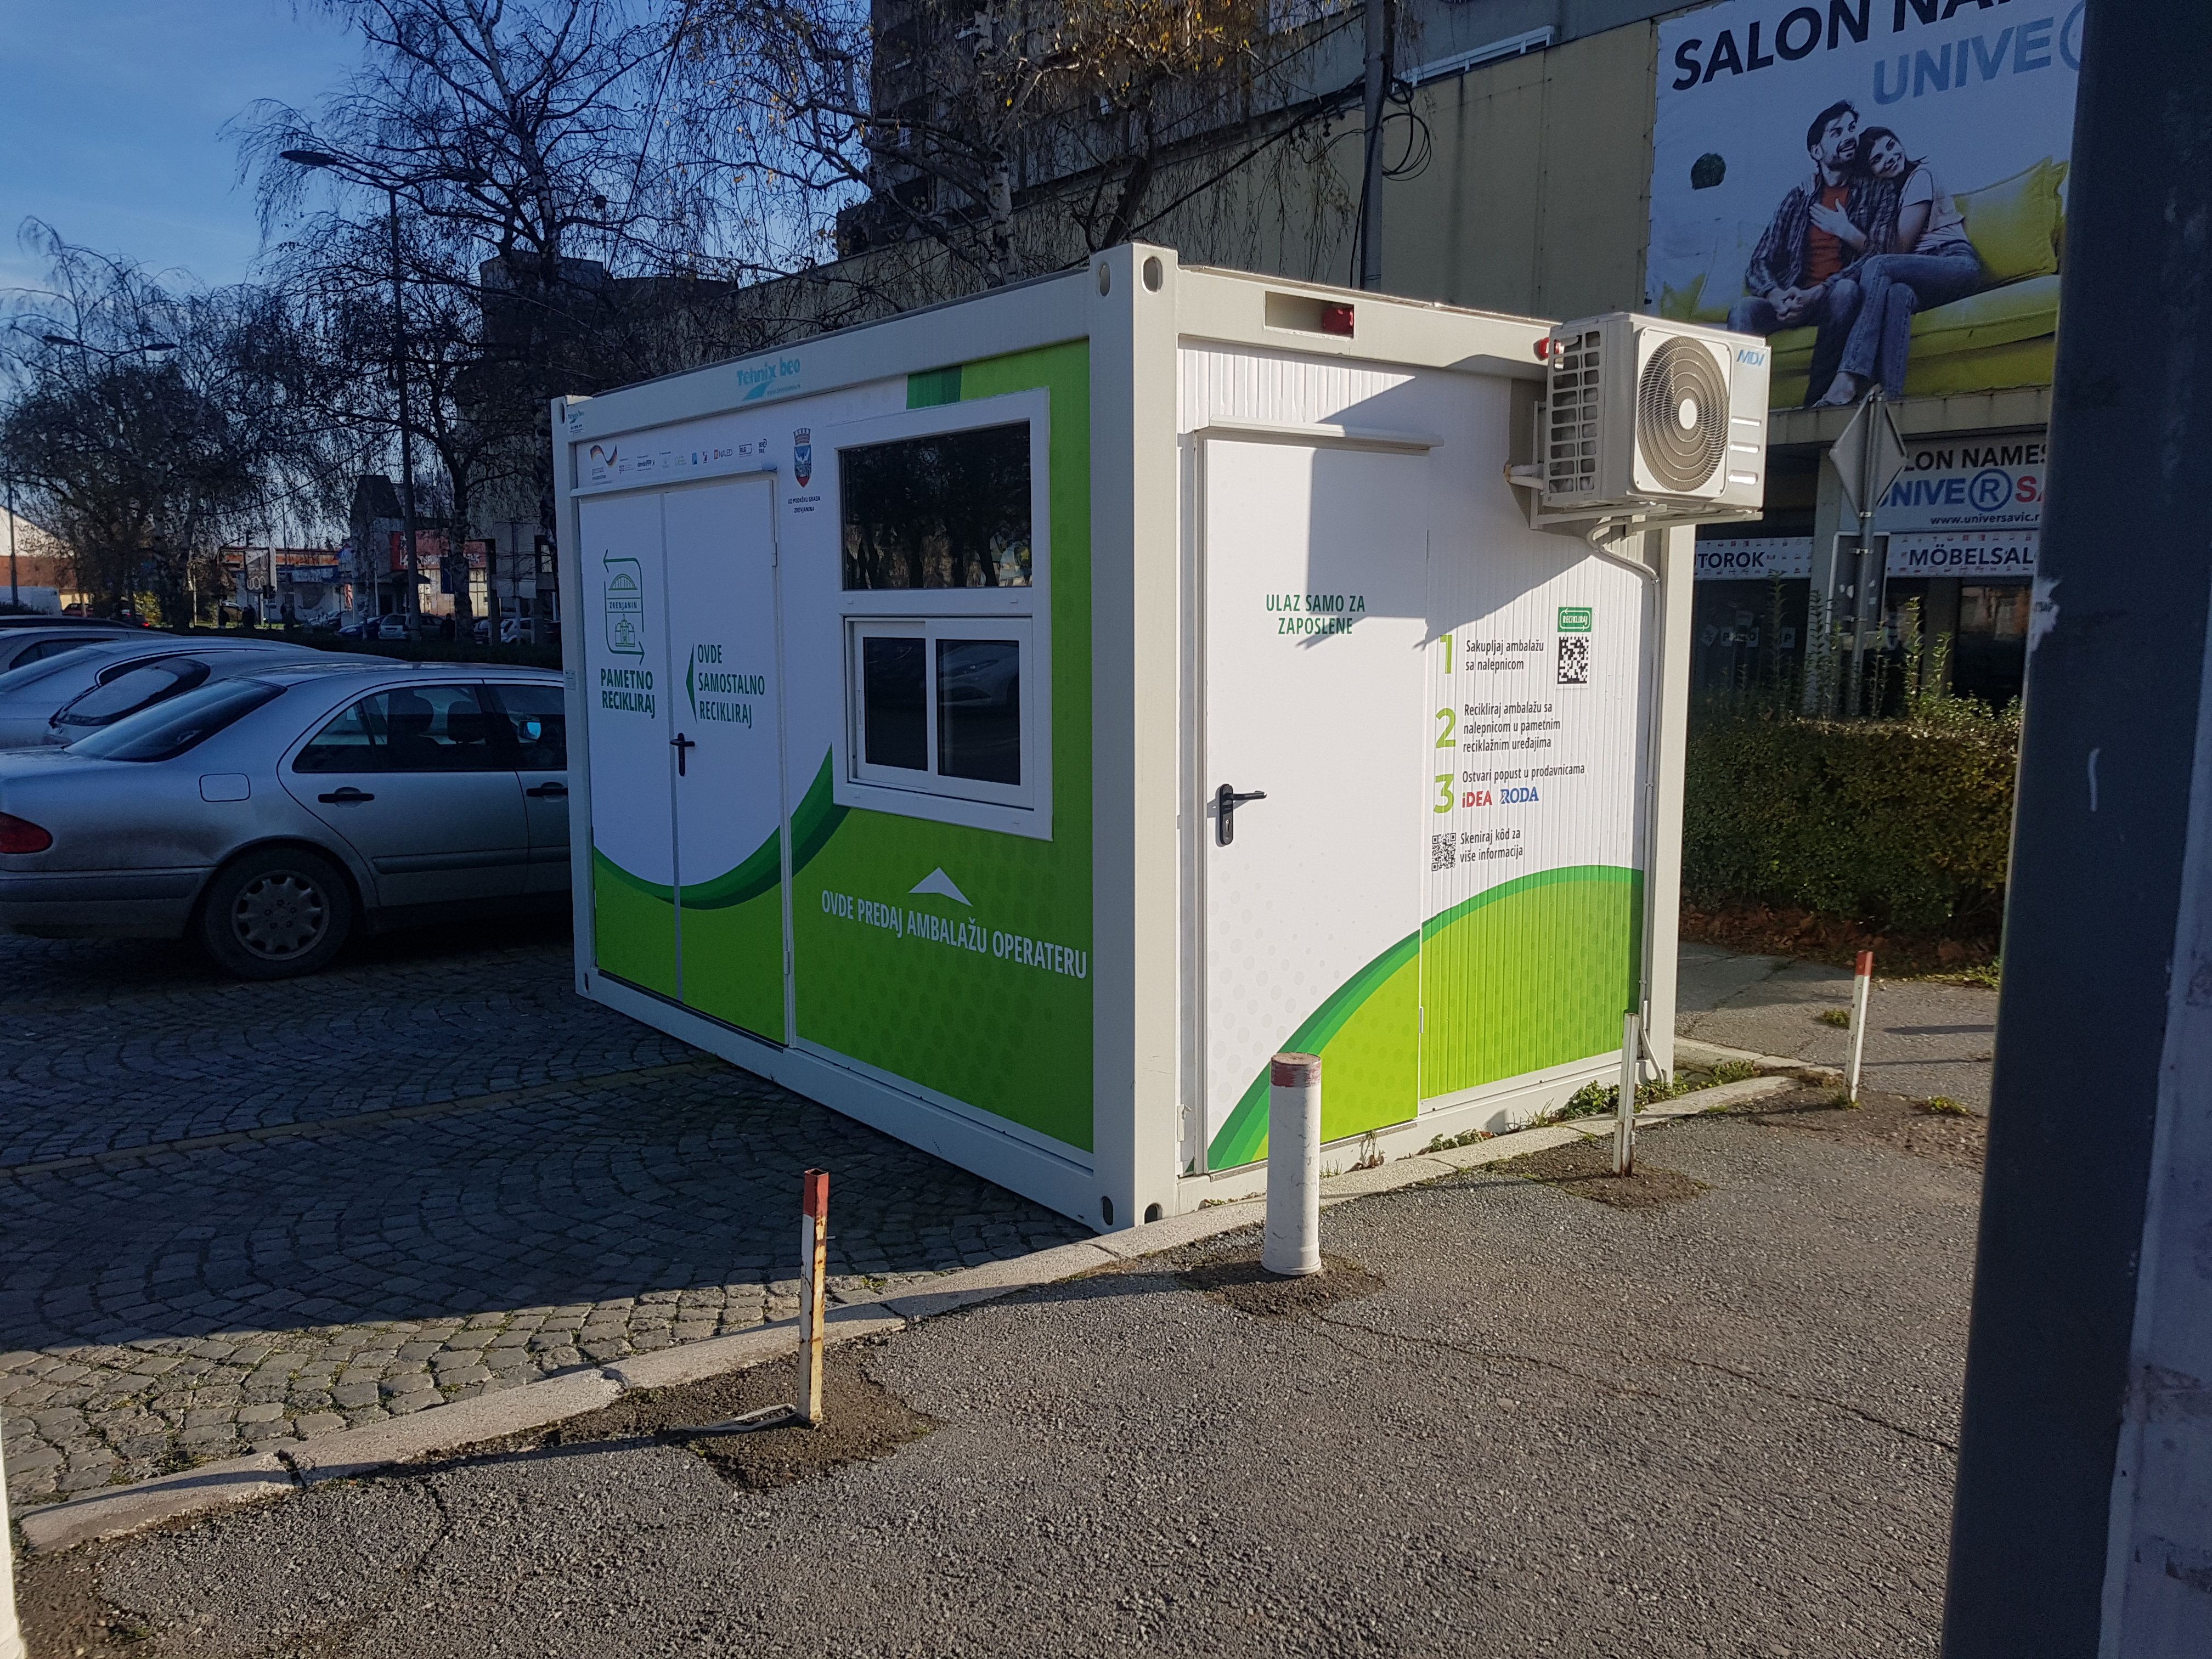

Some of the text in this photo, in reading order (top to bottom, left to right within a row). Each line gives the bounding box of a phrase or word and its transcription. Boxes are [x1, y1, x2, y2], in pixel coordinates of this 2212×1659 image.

[1672, 0, 1871, 91] SALON
[780, 356, 800, 376] beo
[1694, 551, 1765, 568] TOROK
[1909, 544, 2036, 566] MÖBELSAL
[609, 601, 637, 610] ZRENJANIN
[1266, 594, 1365, 612] ULAZ SAMO ZA
[1278, 617, 1353, 635] ZAPOSLENE
[1562, 615, 1588, 626] RECIKLIRAJ
[697, 644, 723, 664] OVDE
[1466, 639, 1544, 656] Sakupljaj ambalažu
[1465, 658, 1524, 674] sa nalepnicom
[601, 668, 653, 690] PAMETNO
[698, 673, 765, 695] SAMOSTALNO
[602, 690, 656, 719] RECIKLIRAJ
[1464, 701, 1553, 718] Recikliraj ambalažu sa
[699, 701, 752, 729] RECIKLIRAJ
[1435, 708, 1456, 748] 2
[1464, 719, 1560, 737] nalepnicom u pametnim
[1463, 737, 1551, 753] reciklažnim uređajima
[1462, 764, 1585, 784] Ostvari popust u prodavnicama
[1434, 774, 1454, 813] 3
[1499, 786, 1539, 804] RODA
[1460, 827, 1521, 845] Skeniraj kôd za
[1460, 845, 1523, 862] više informacija
[821, 889, 1087, 979] OVDE PREDAJ AMBALAŽU OPERATERU
